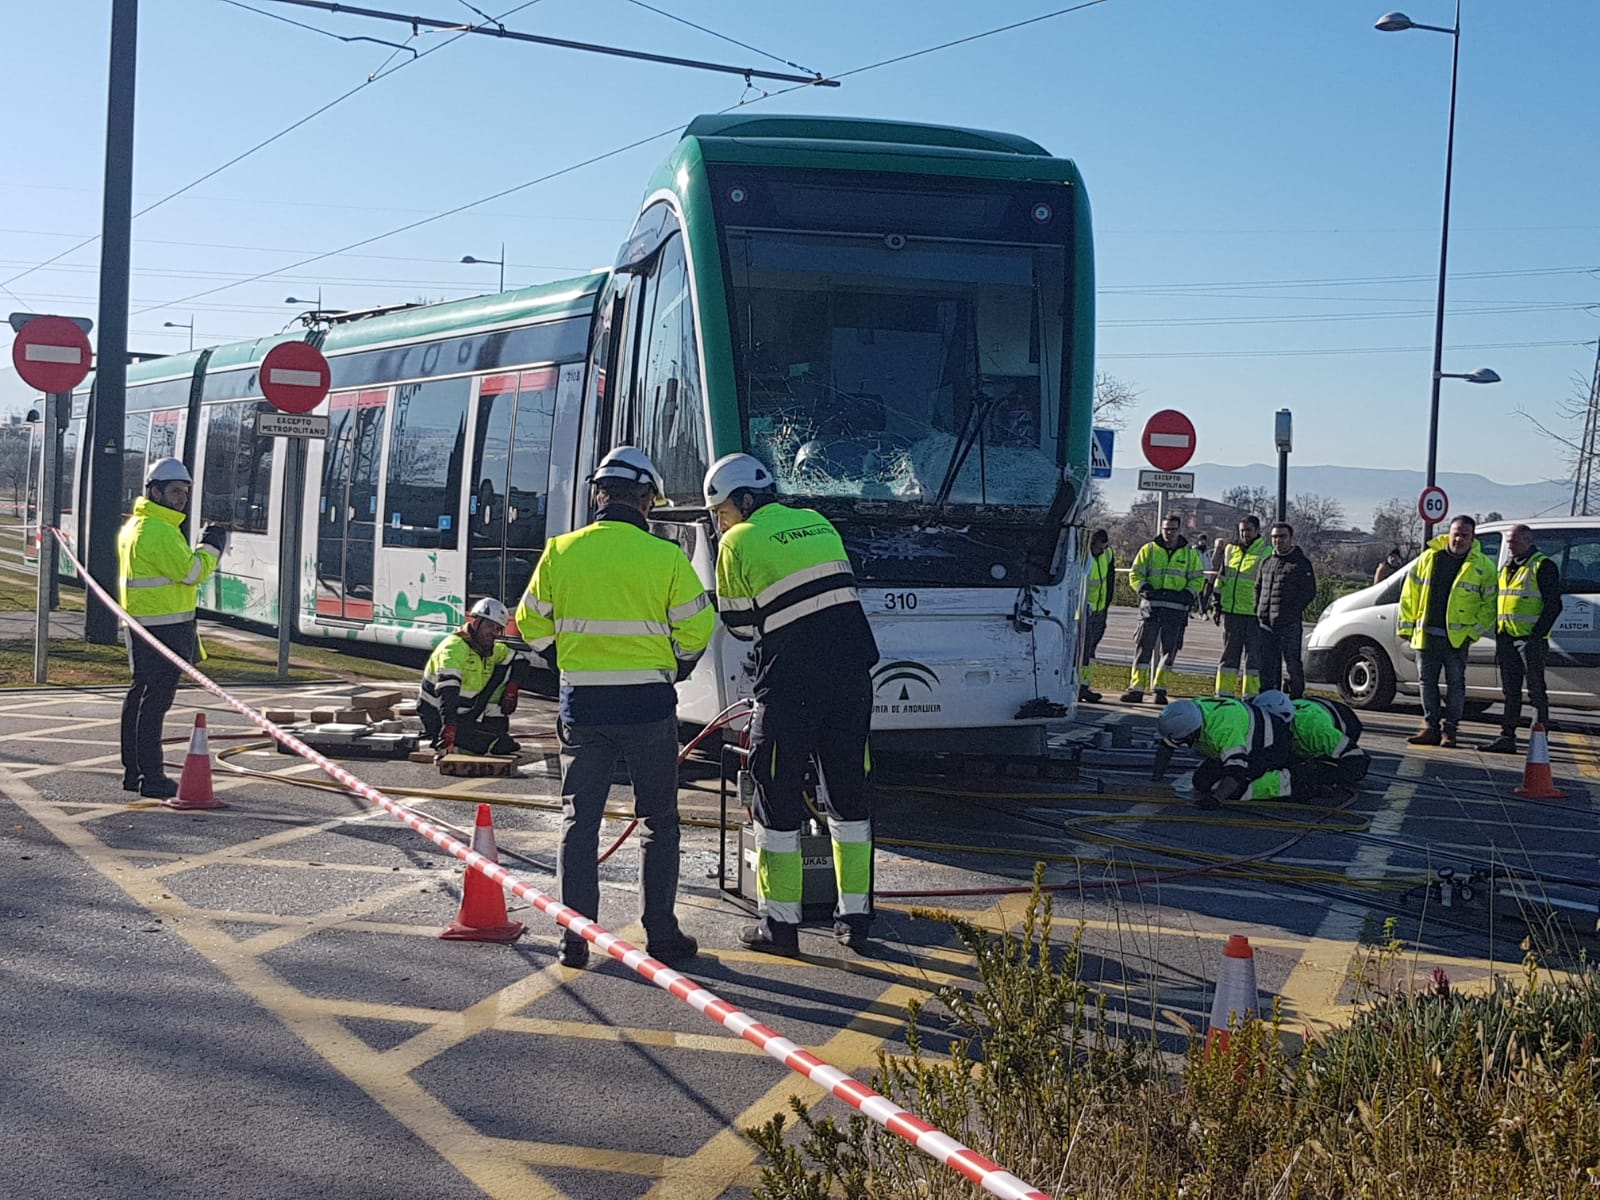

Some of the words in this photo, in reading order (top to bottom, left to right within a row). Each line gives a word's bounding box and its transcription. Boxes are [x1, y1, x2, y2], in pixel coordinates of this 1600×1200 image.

[276, 417, 312, 426] EXCEPTO
[262, 425, 326, 435] METROPOLITANO
[1426, 498, 1443, 511] 60
[884, 592, 917, 610] 310
[891, 704, 900, 713] DE
[801, 857, 828, 867] UKAS
